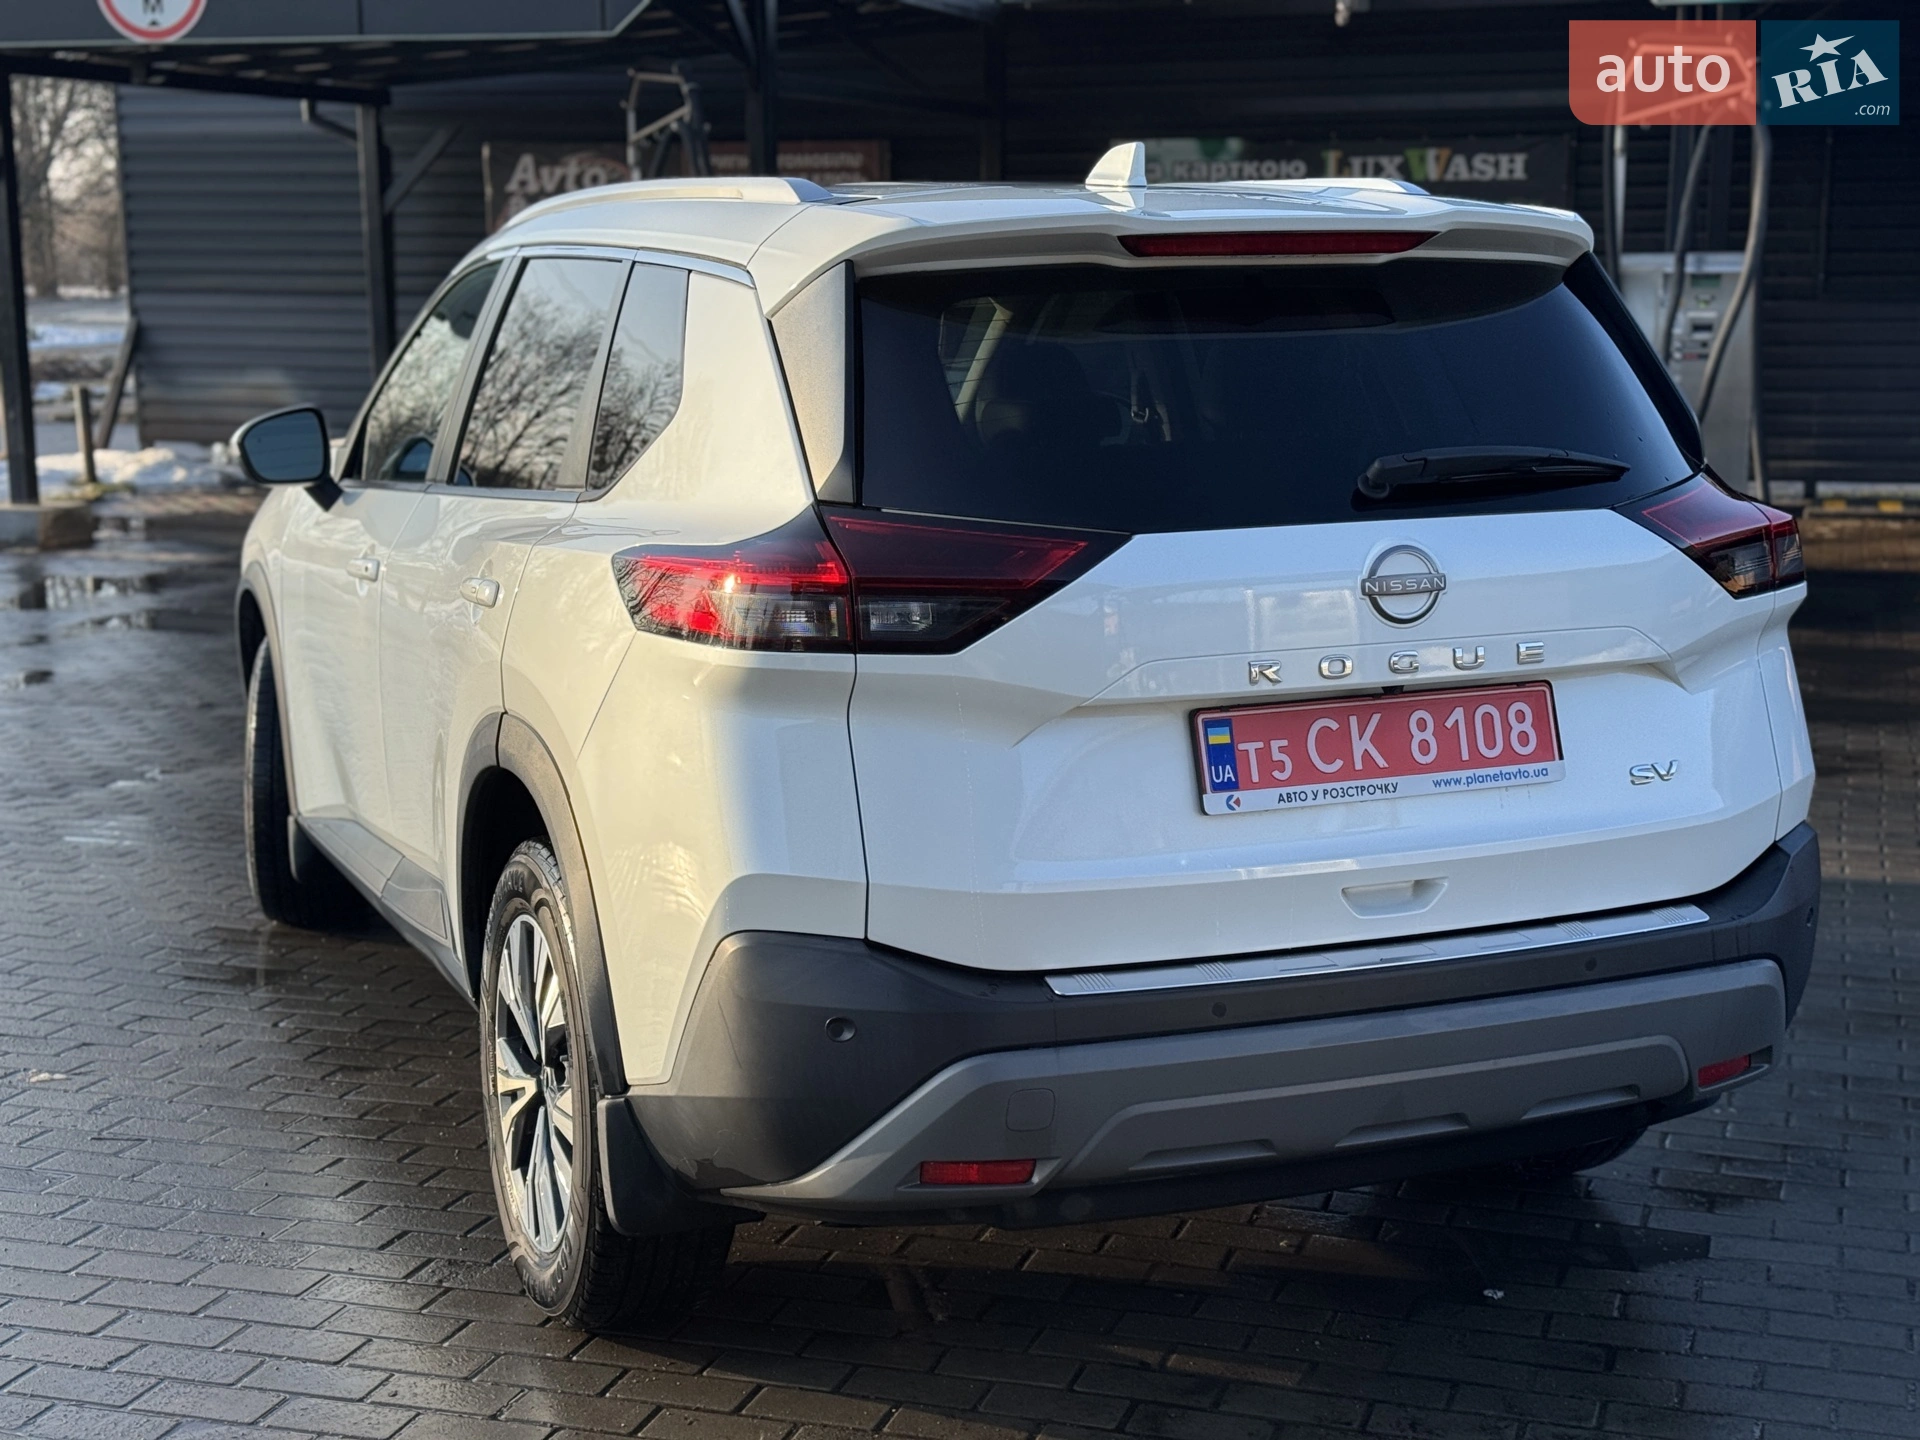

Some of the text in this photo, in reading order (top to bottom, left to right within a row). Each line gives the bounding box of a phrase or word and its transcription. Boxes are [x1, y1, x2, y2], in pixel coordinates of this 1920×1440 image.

[504, 153, 607, 194] Avto
[1364, 572, 1446, 594] NISSAN
[1248, 640, 1546, 686] ROGUE
[1237, 701, 1538, 784] T5 CK 8108
[1211, 764, 1236, 783] UA
[1432, 766, 1549, 788] www.planetavto.ua
[1628, 759, 1680, 786] SV
[1277, 782, 1399, 804] АВТО У РОЗСТРОЧКУ
